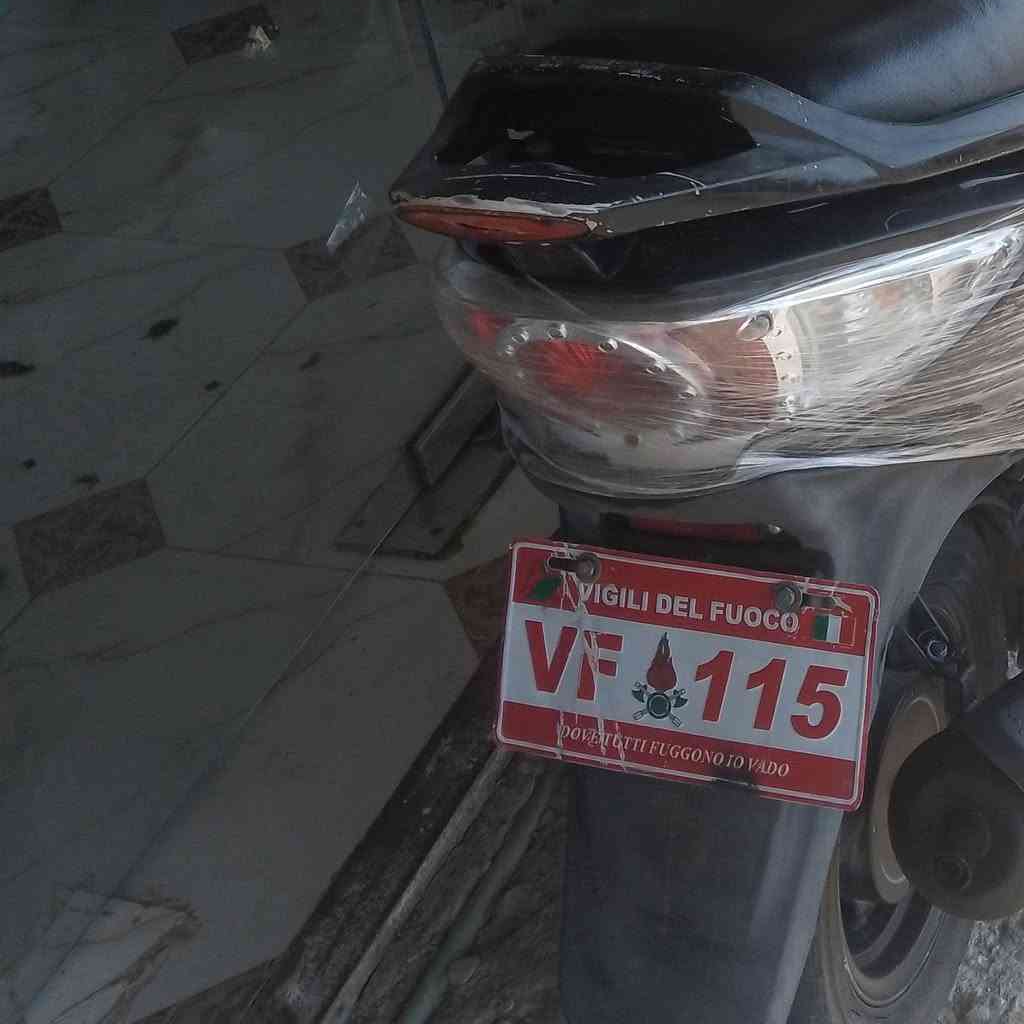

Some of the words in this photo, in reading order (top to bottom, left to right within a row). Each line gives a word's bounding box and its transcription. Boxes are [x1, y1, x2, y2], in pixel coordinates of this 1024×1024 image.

[578, 582, 650, 612] VIGILI
[655, 592, 704, 621] DEL
[710, 600, 800, 634] FUOCO
[523, 618, 625, 702] VF
[694, 648, 849, 742] 115
[649, 742, 725, 767] FUGGONO
[726, 753, 745, 769] IO
[749, 758, 791, 778] VADO
